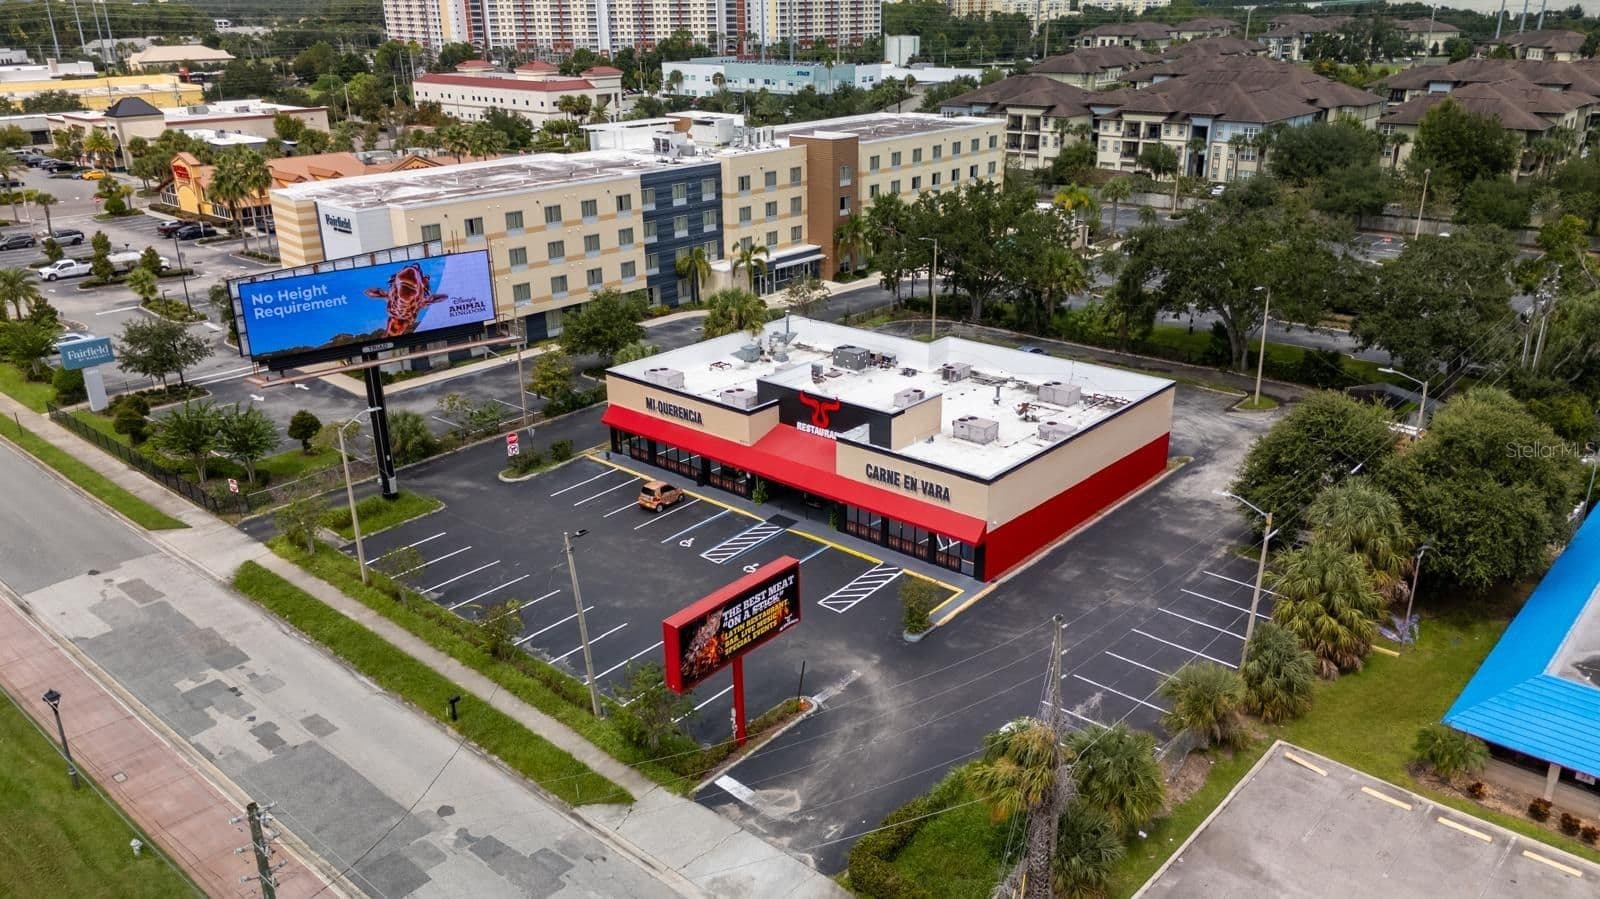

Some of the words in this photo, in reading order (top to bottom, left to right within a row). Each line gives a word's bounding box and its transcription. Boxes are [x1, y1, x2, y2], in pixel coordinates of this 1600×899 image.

[251, 293, 273, 306] No
[277, 284, 328, 301] Height
[254, 294, 348, 320] Requirement
[449, 301, 486, 312] ANIMAL
[449, 307, 487, 317] KINGDOM
[67, 344, 109, 360] Fairfield
[645, 396, 656, 410] MI
[657, 400, 703, 425] QUERENCIA
[866, 463, 900, 487] CARNE
[903, 474, 918, 492] EN
[921, 480, 951, 502] VARA
[722, 603, 743, 621] THE
[743, 590, 767, 610] BEST
[768, 575, 795, 597] MEAT
[743, 609, 751, 620] A
[724, 622, 746, 641] LATIN
[724, 634, 752, 656] SPECIAL
[752, 619, 778, 640] EVENTS
